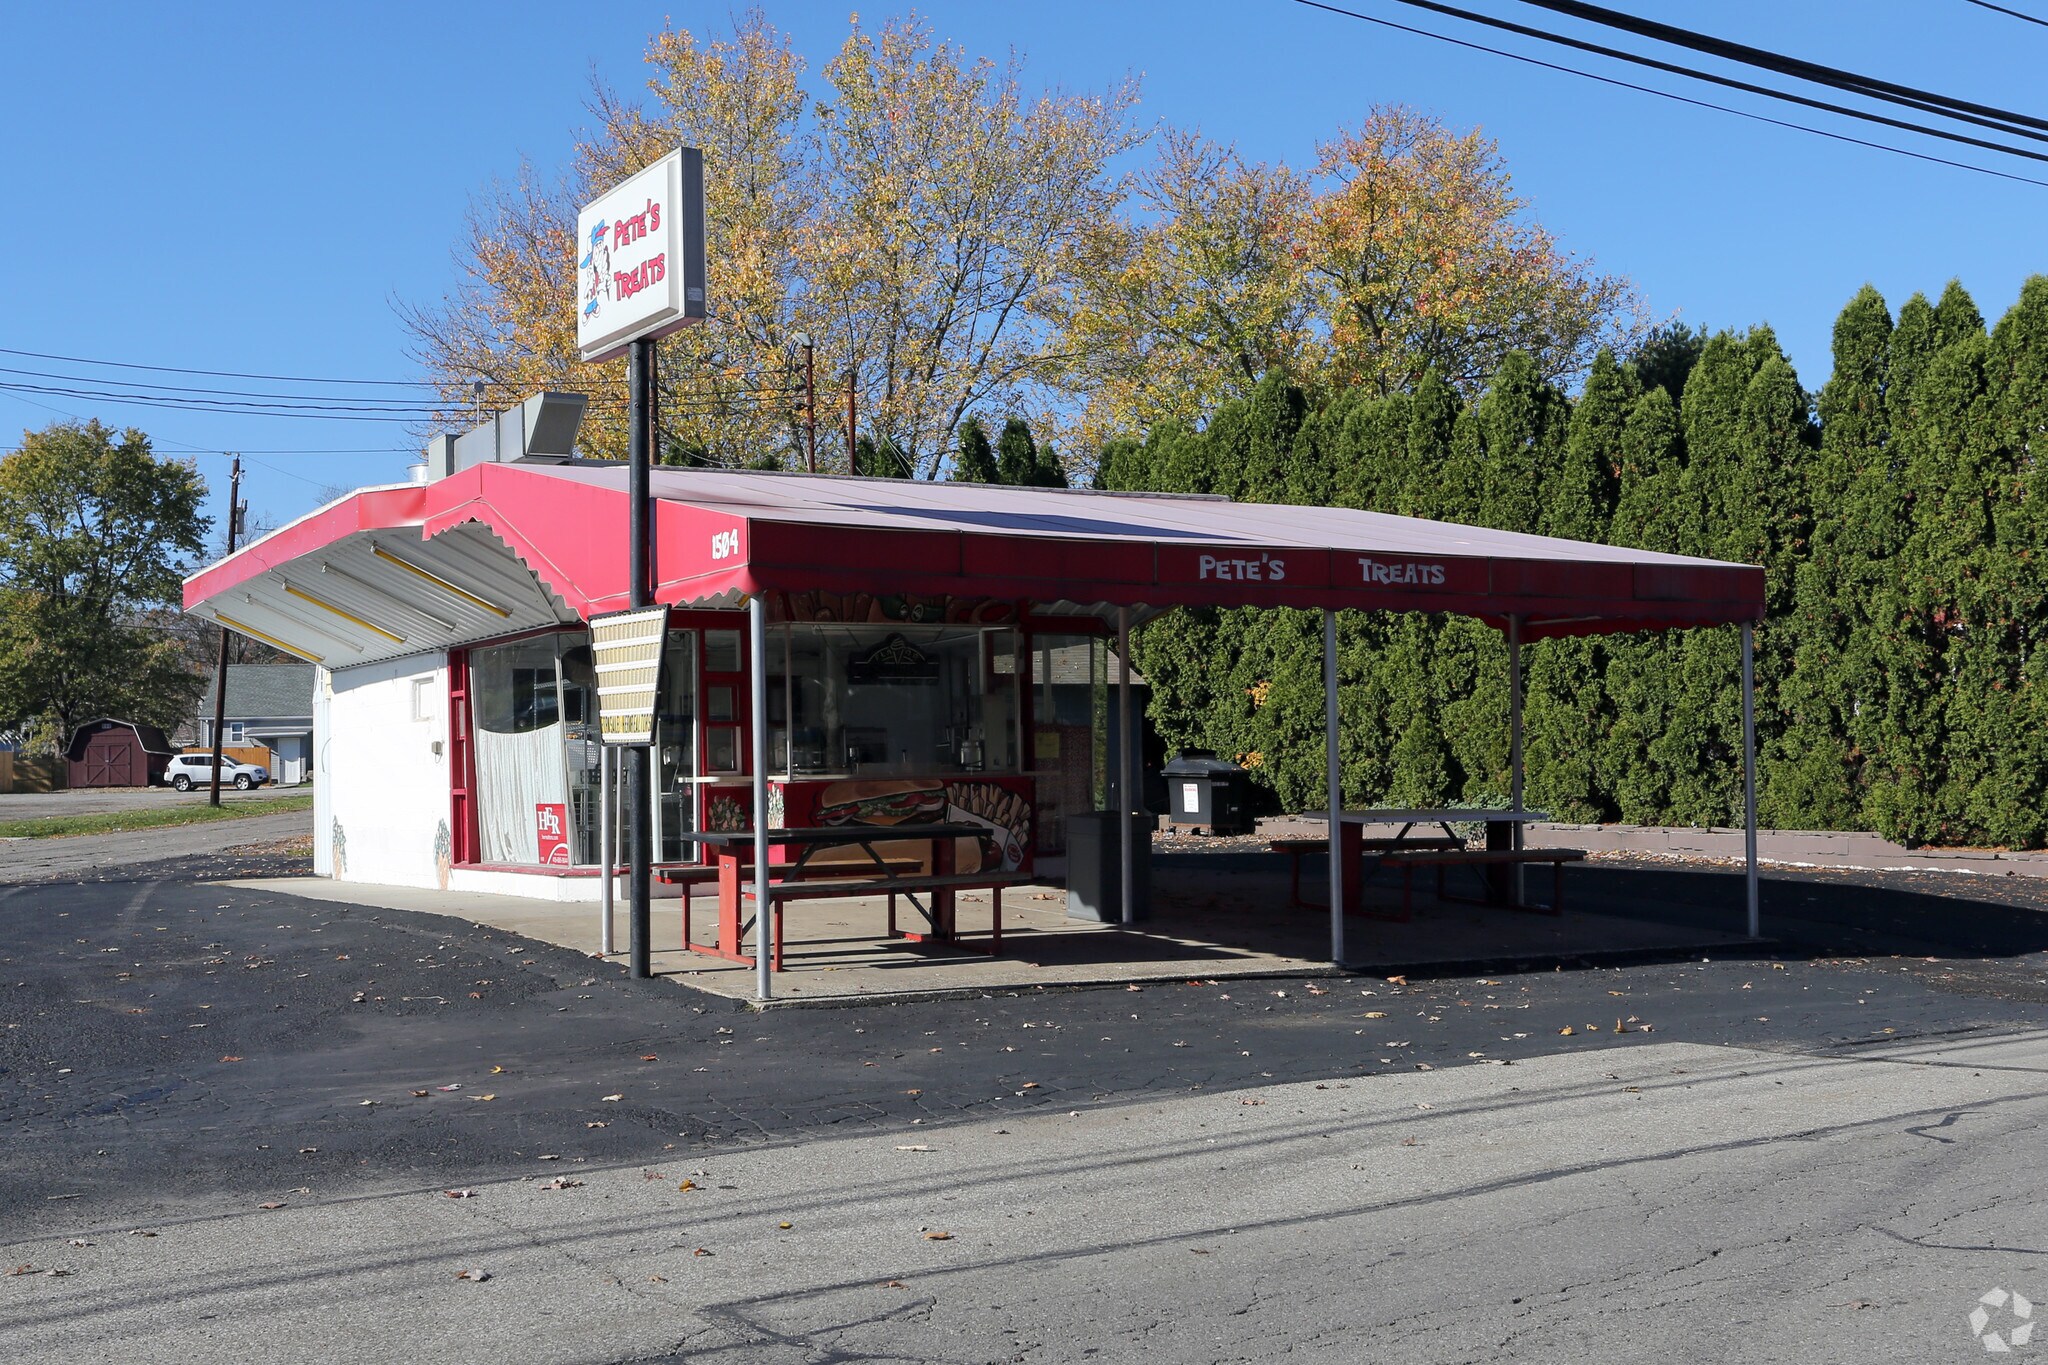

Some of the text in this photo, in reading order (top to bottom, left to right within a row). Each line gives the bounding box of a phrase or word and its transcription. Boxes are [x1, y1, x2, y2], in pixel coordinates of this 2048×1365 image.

[613, 198, 661, 252] PETE'S
[613, 253, 665, 301] TREATS
[711, 528, 739, 559] 1504
[1199, 552, 1445, 585] PETE'S TREATS
